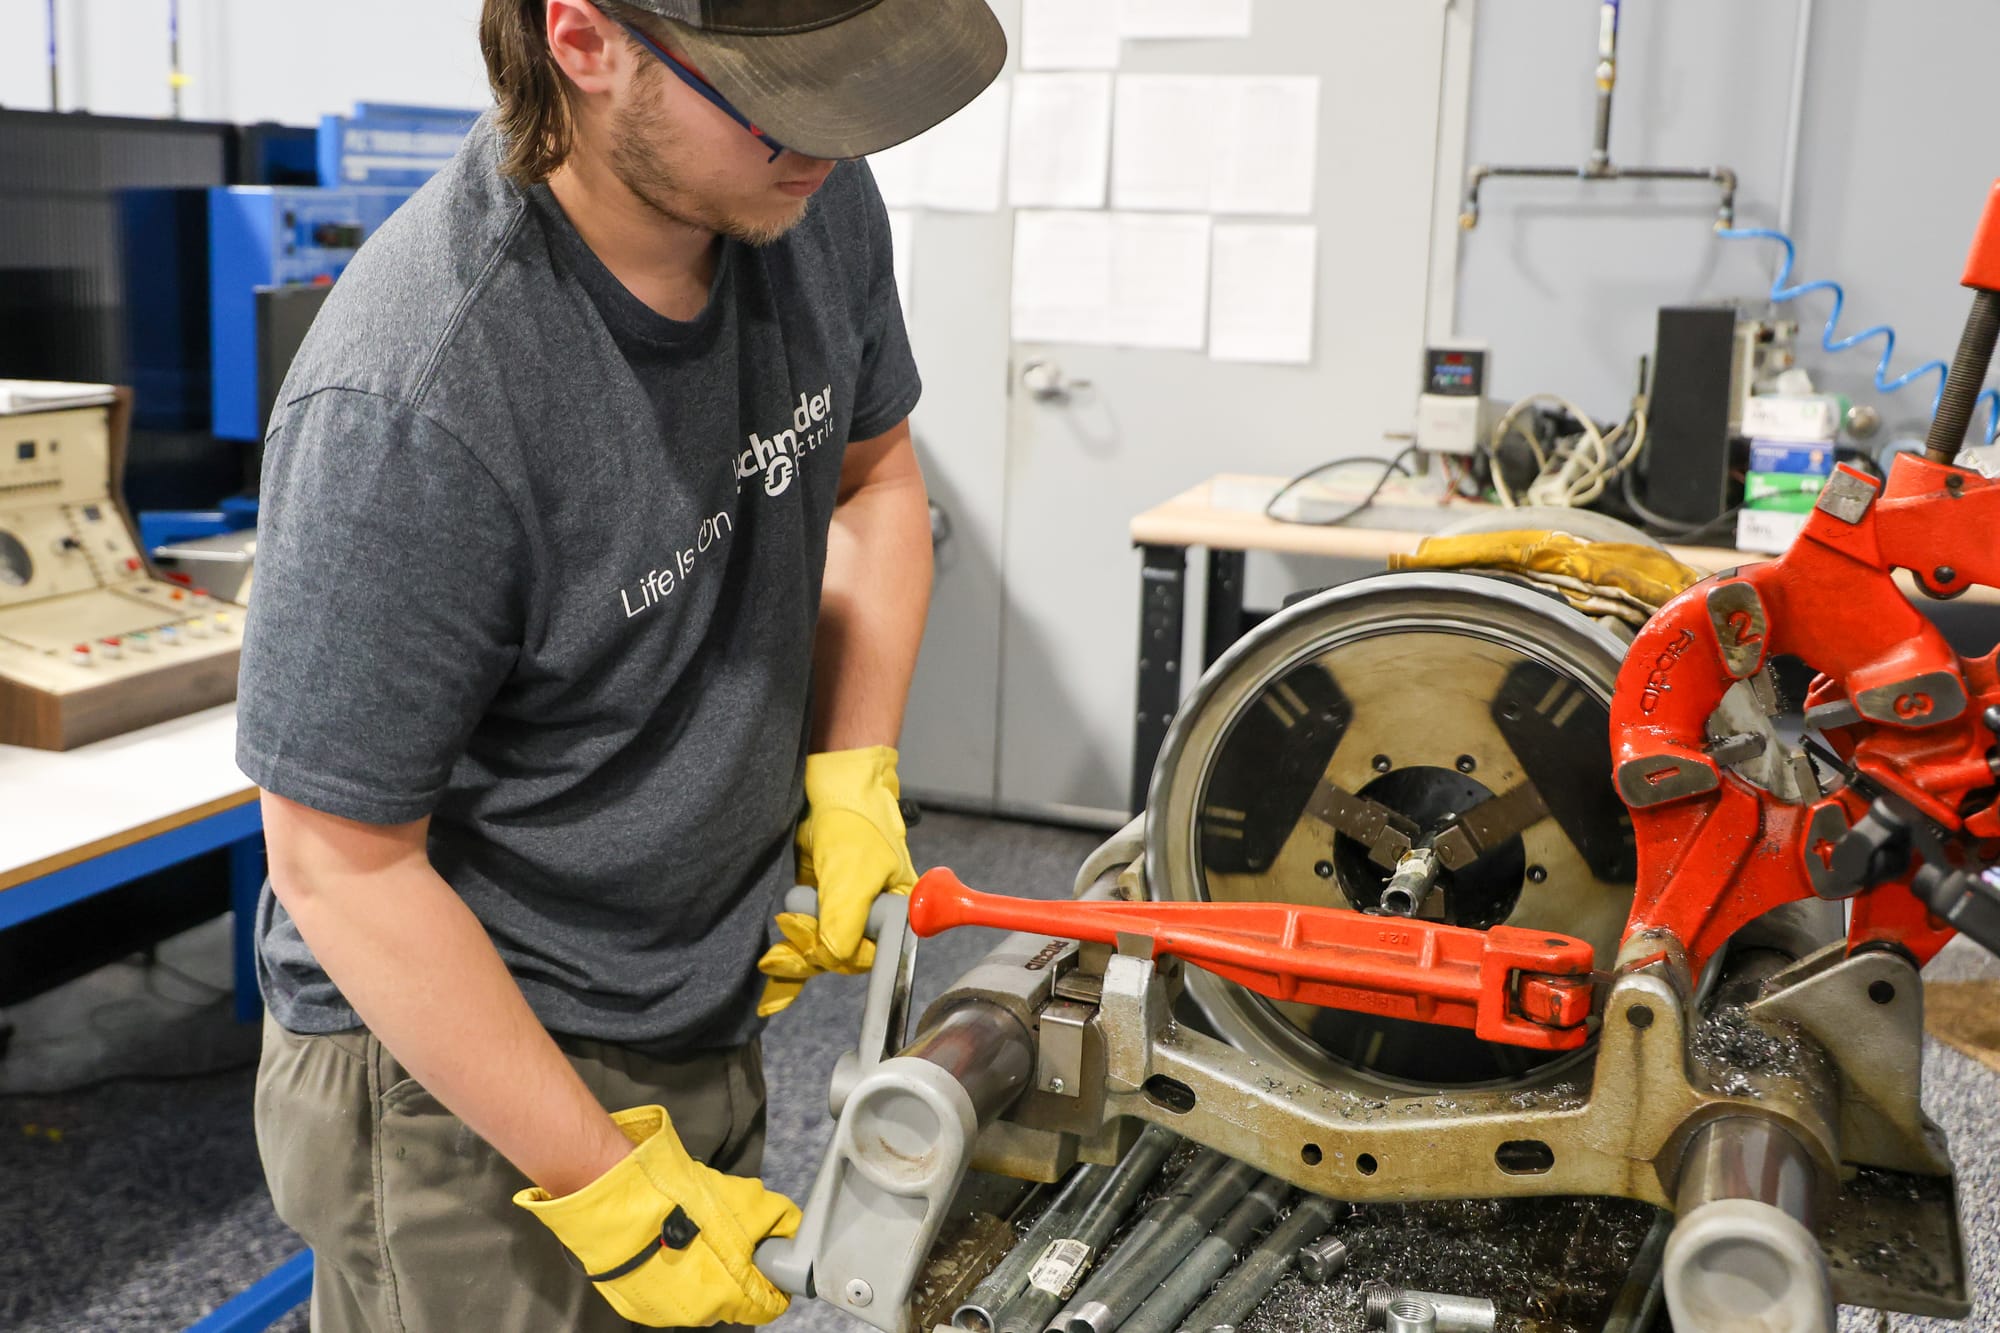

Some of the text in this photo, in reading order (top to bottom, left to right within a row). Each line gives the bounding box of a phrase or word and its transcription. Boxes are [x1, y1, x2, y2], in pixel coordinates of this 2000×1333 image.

[732, 384, 831, 494] chnder
[621, 570, 675, 618] Life
[676, 548, 695, 579] Is
[1728, 610, 1762, 647] 2
[1893, 692, 1935, 719] 3
[1643, 766, 1681, 785] 1
